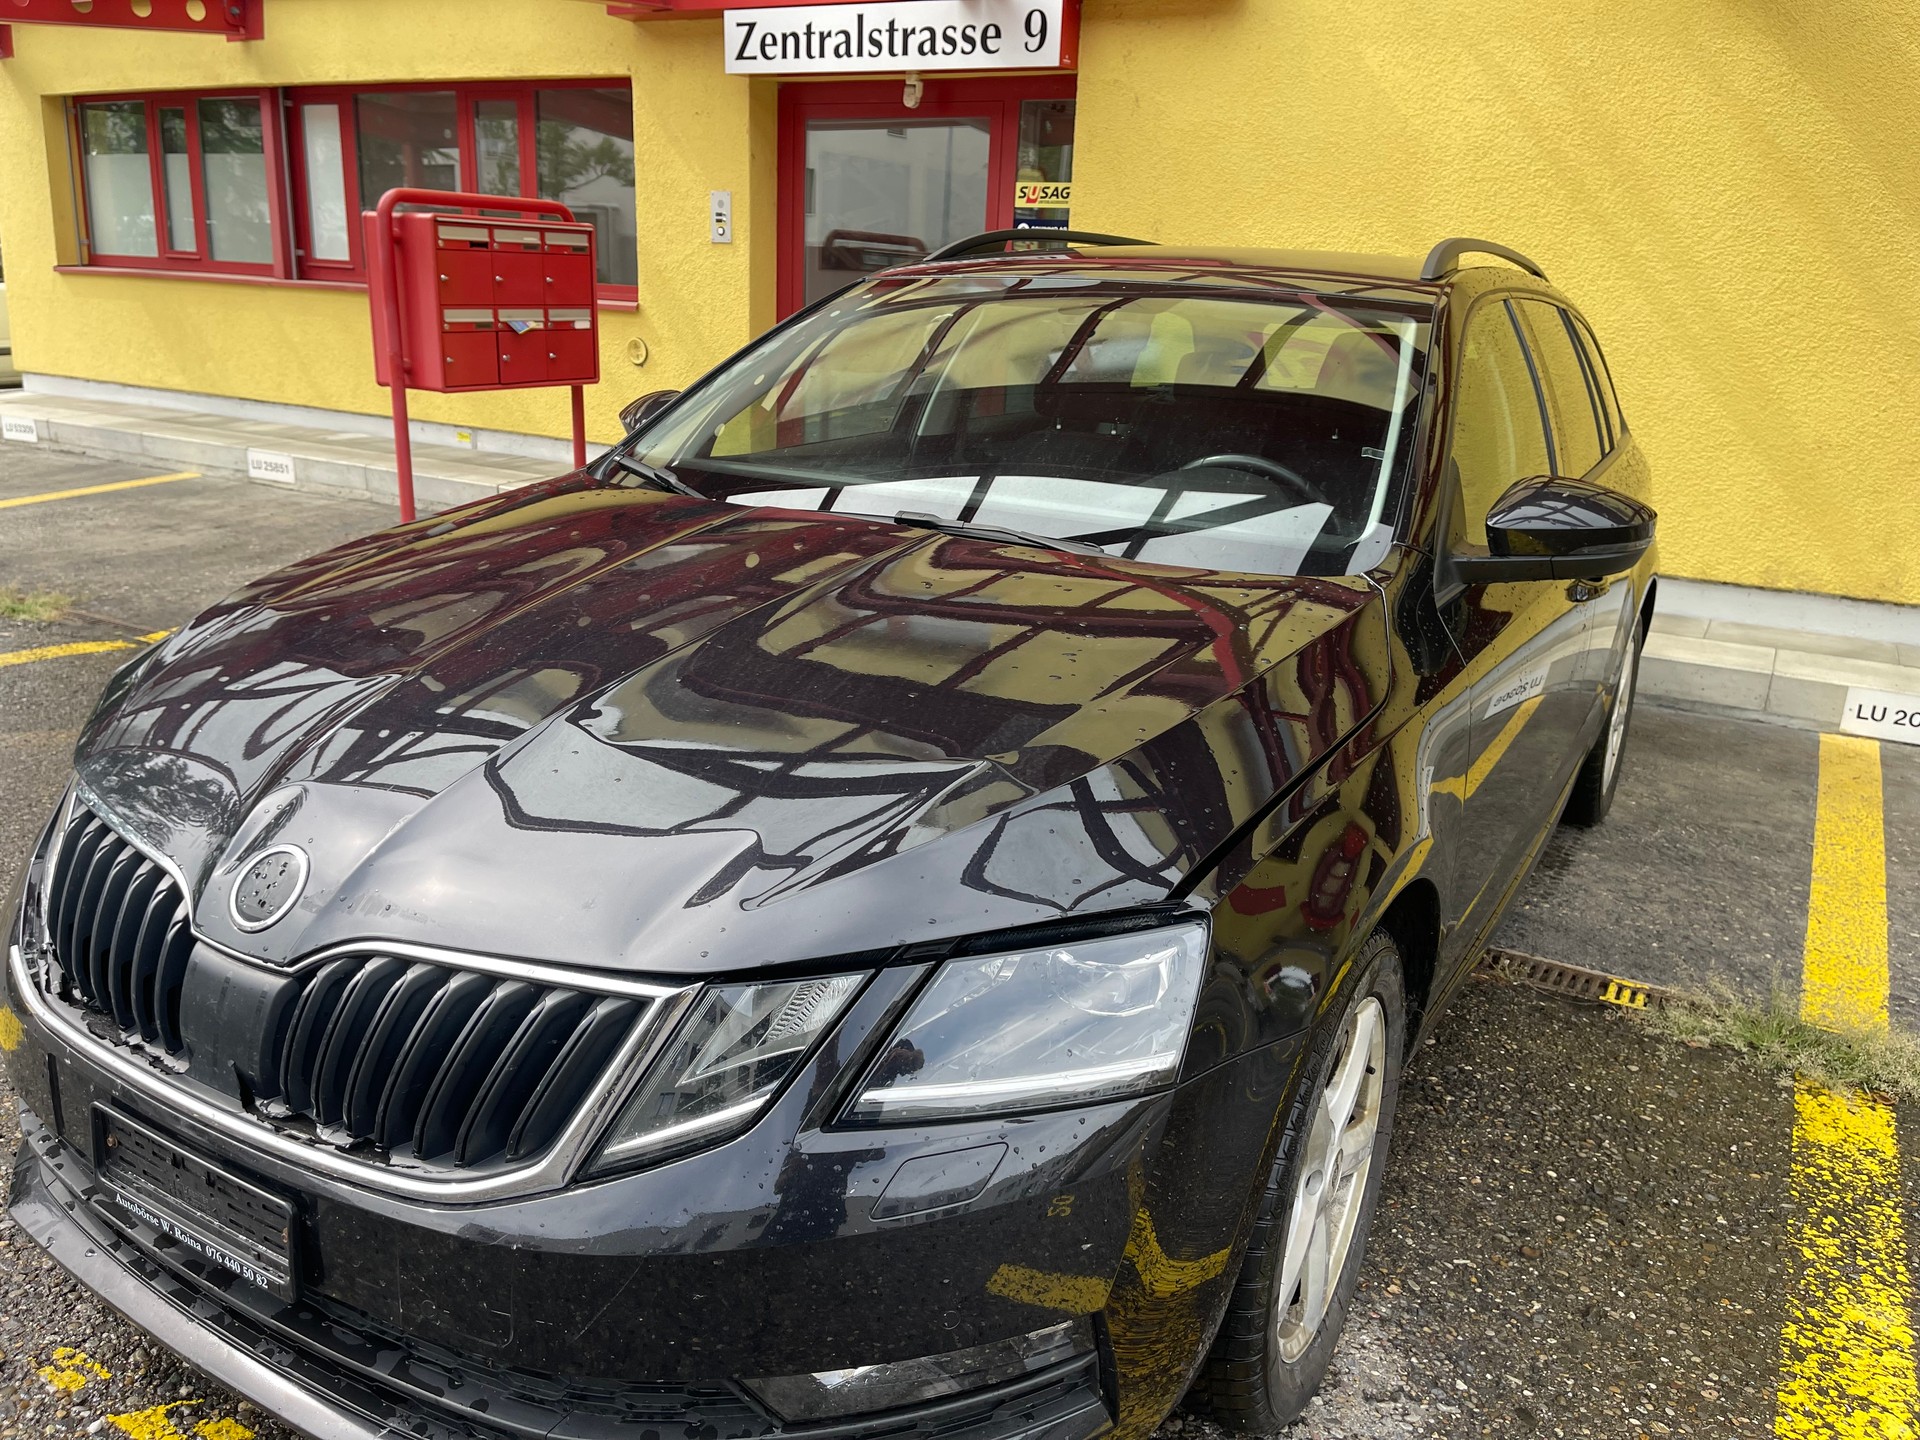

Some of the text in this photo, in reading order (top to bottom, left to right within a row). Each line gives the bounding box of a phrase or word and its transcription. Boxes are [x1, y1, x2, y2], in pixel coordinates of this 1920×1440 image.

[735, 9, 1048, 61] Zentralstrasse 9
[1018, 185, 1071, 201] SUSAG
[251, 459, 263, 470] LU
[1856, 703, 1888, 722] LU
[115, 1192, 269, 1289] Autobörse W. Roina 076 440 50 82
